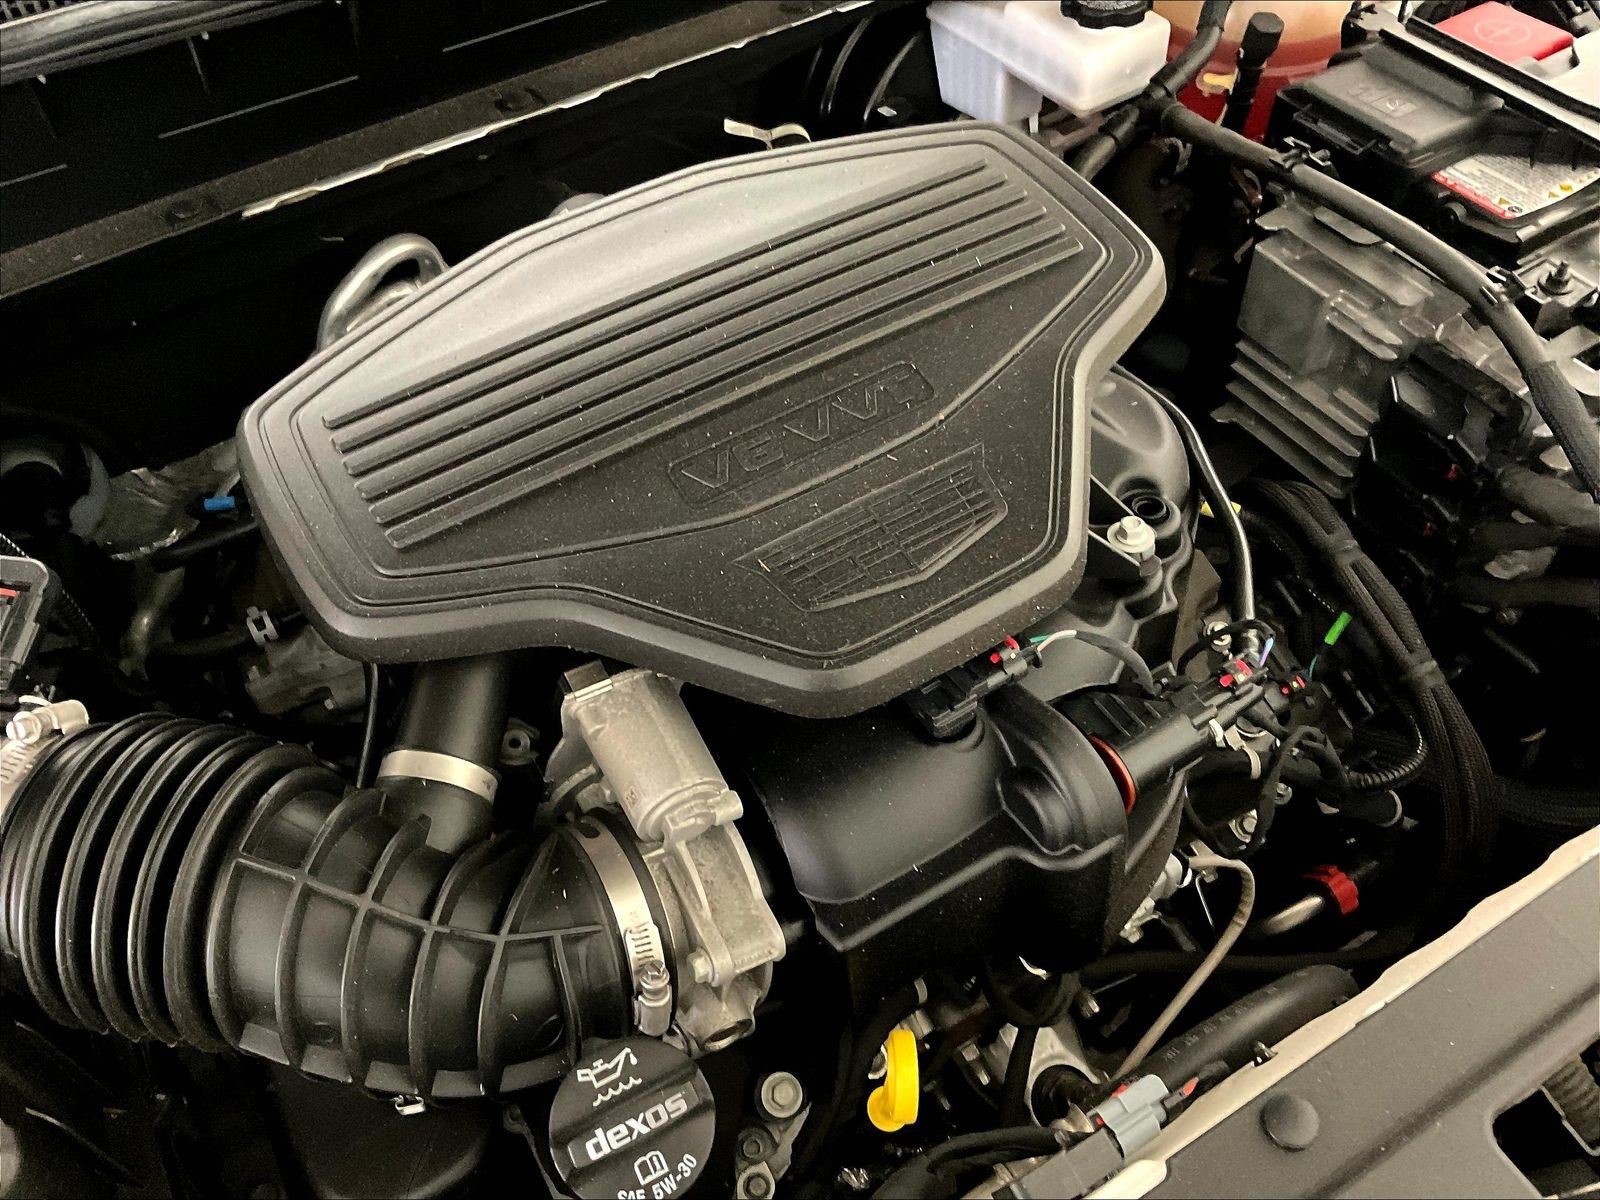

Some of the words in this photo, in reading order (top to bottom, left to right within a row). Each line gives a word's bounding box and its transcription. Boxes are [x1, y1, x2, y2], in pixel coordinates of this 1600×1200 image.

[681, 435, 785, 489] V6
[585, 1092, 688, 1161] dexos
[651, 1153, 697, 1200] 5W-30
